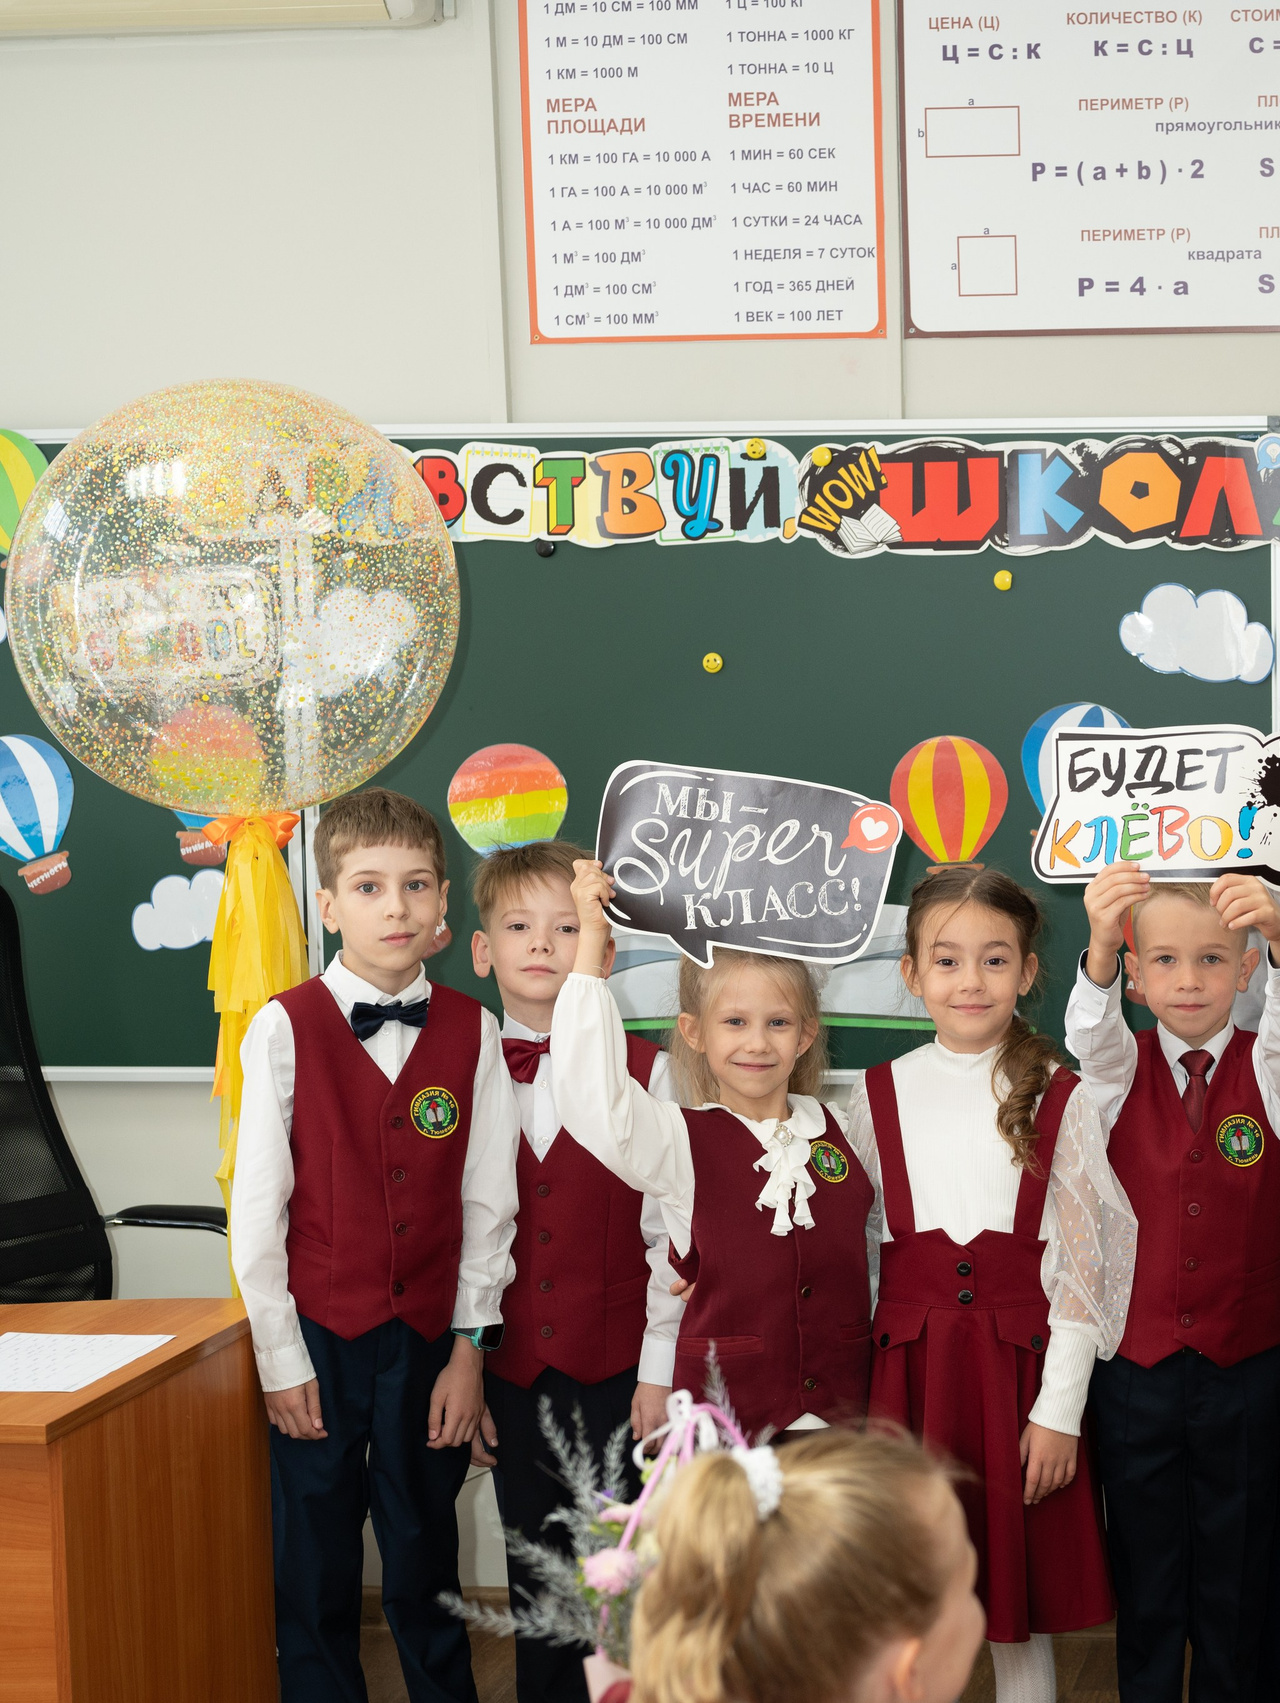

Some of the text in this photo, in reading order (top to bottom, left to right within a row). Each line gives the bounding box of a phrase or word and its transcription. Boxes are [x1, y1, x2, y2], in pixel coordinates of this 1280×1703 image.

[928, 15, 1001, 31] ЦЕНА (Ц)
[1067, 10, 1202, 26] КОЛИЧЕСТВО (К)
[727, 32, 732, 42] 1
[738, 31, 787, 42] ТОННА
[804, 29, 834, 40] 1000
[839, 29, 855, 40] КГ
[547, 98, 597, 113] МЕРА
[729, 92, 779, 107] МЕРА
[1079, 97, 1188, 112] ПЕРИМЕТР (P)
[547, 118, 645, 135] ПЛОЩАДИ
[729, 112, 820, 128] ВРЕМЕНИ
[732, 217, 737, 227] 1
[743, 216, 787, 227] СУТКИ
[805, 215, 819, 226] 24
[824, 214, 862, 225] ЧАСА
[1081, 228, 1190, 243] ПЕРИМЕТР (P)
[733, 250, 738, 260] 1
[745, 249, 801, 262] НЕДЕЛЯ
[818, 248, 825, 259] 7
[830, 247, 875, 258] СУТОК
[1188, 250, 1261, 263] квадрата
[734, 282, 738, 292] 1
[746, 281, 773, 294] ГОД
[789, 281, 811, 291] 365
[816, 277, 854, 293] ДНЕЙ
[1078, 278, 1094, 297] P
[1130, 277, 1146, 296] 4
[1173, 281, 1188, 295] a
[735, 312, 739, 322] 1
[746, 311, 773, 322] ВЕК
[790, 311, 811, 321] 100
[816, 310, 843, 321] ЛЕТ
[800, 445, 888, 533] WOW!
[1068, 745, 1245, 799] БУДЕТ
[652, 782, 735, 823] МЫ
[1049, 803, 1259, 870] КЛЁВО!
[181, 840, 213, 856] ВНИМА
[613, 818, 847, 906] Super
[28, 861, 68, 889] ЧЕСТНОСТЬ
[682, 877, 862, 930] КЛАСС!
